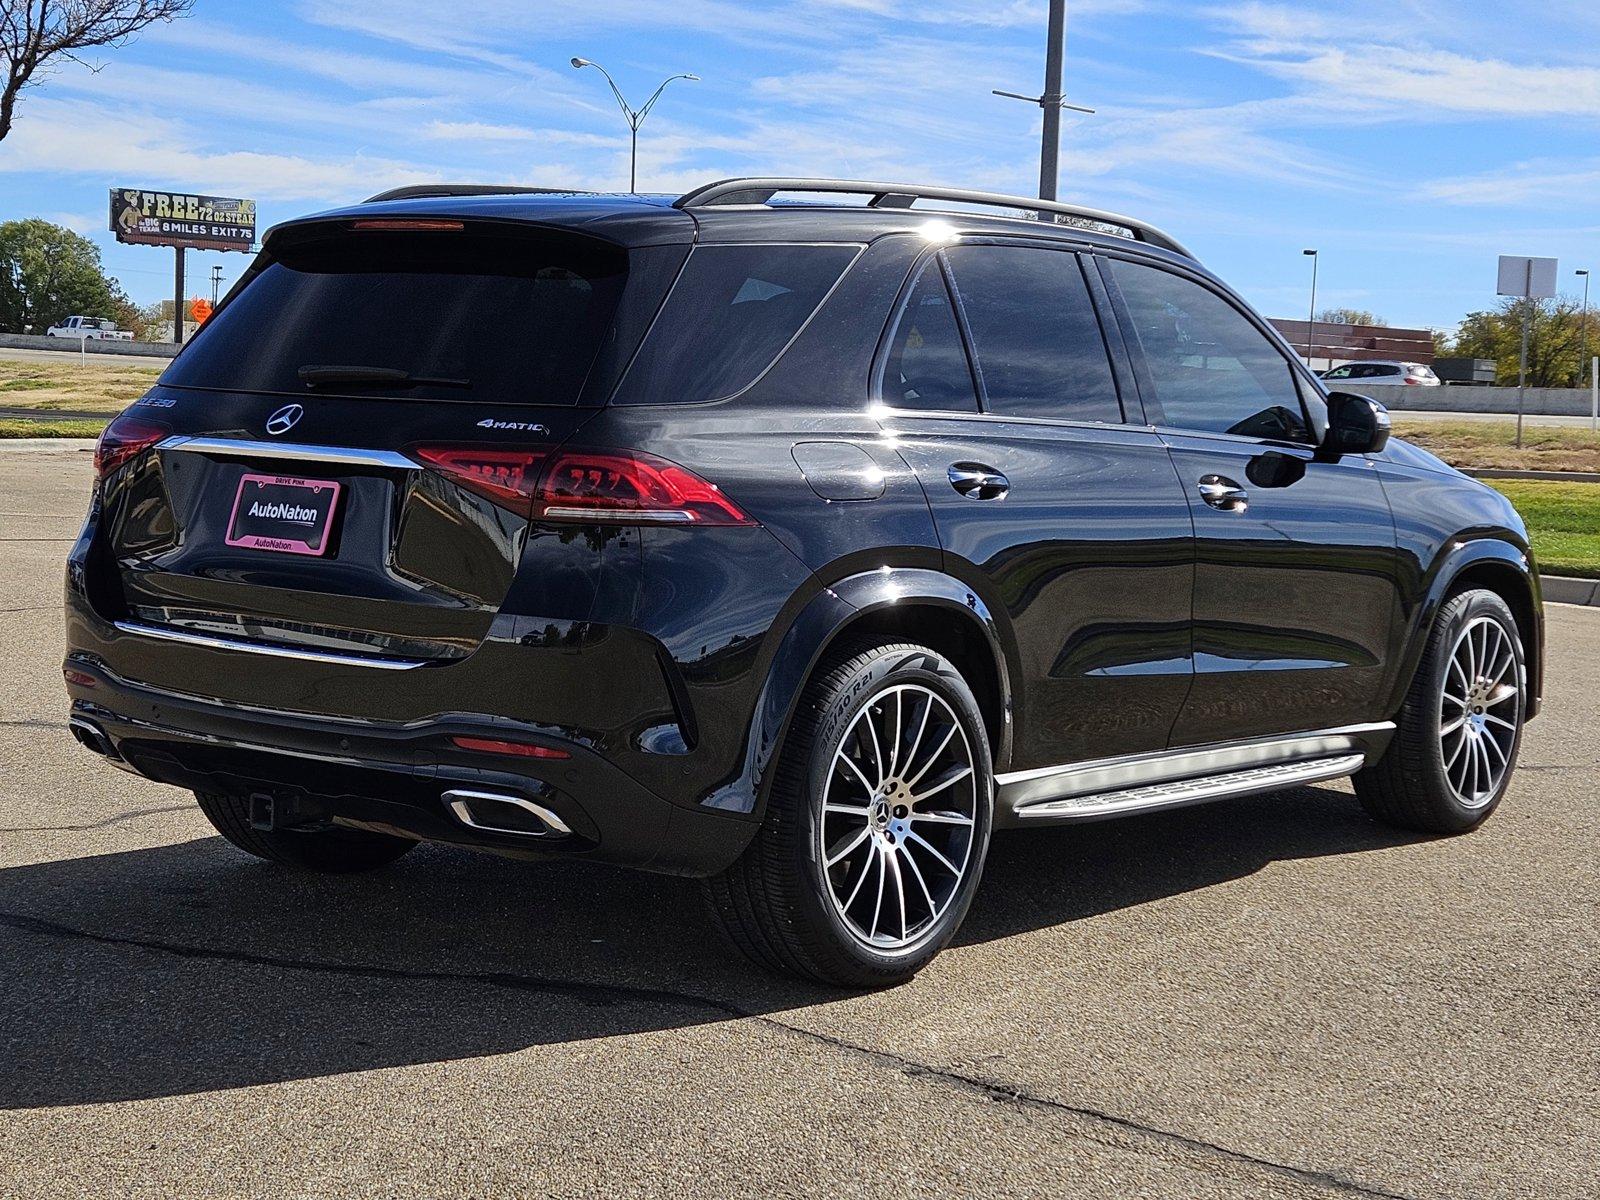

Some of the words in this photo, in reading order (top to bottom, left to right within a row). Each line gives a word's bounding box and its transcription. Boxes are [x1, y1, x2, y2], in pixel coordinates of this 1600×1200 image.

[141, 192, 199, 220] FREE
[144, 218, 160, 227] BIG
[198, 206, 213, 221] 72
[213, 211, 225, 222] OZ
[225, 212, 255, 225] STEAK
[162, 223, 170, 232] 8
[171, 224, 207, 235] MILES
[211, 226, 238, 237] EXIT
[239, 229, 253, 239] 75
[476, 418, 544, 431] 4MATIC
[275, 477, 292, 485] DRIVE
[248, 501, 317, 521] AutoNation
[254, 539, 291, 549] AutoNation
